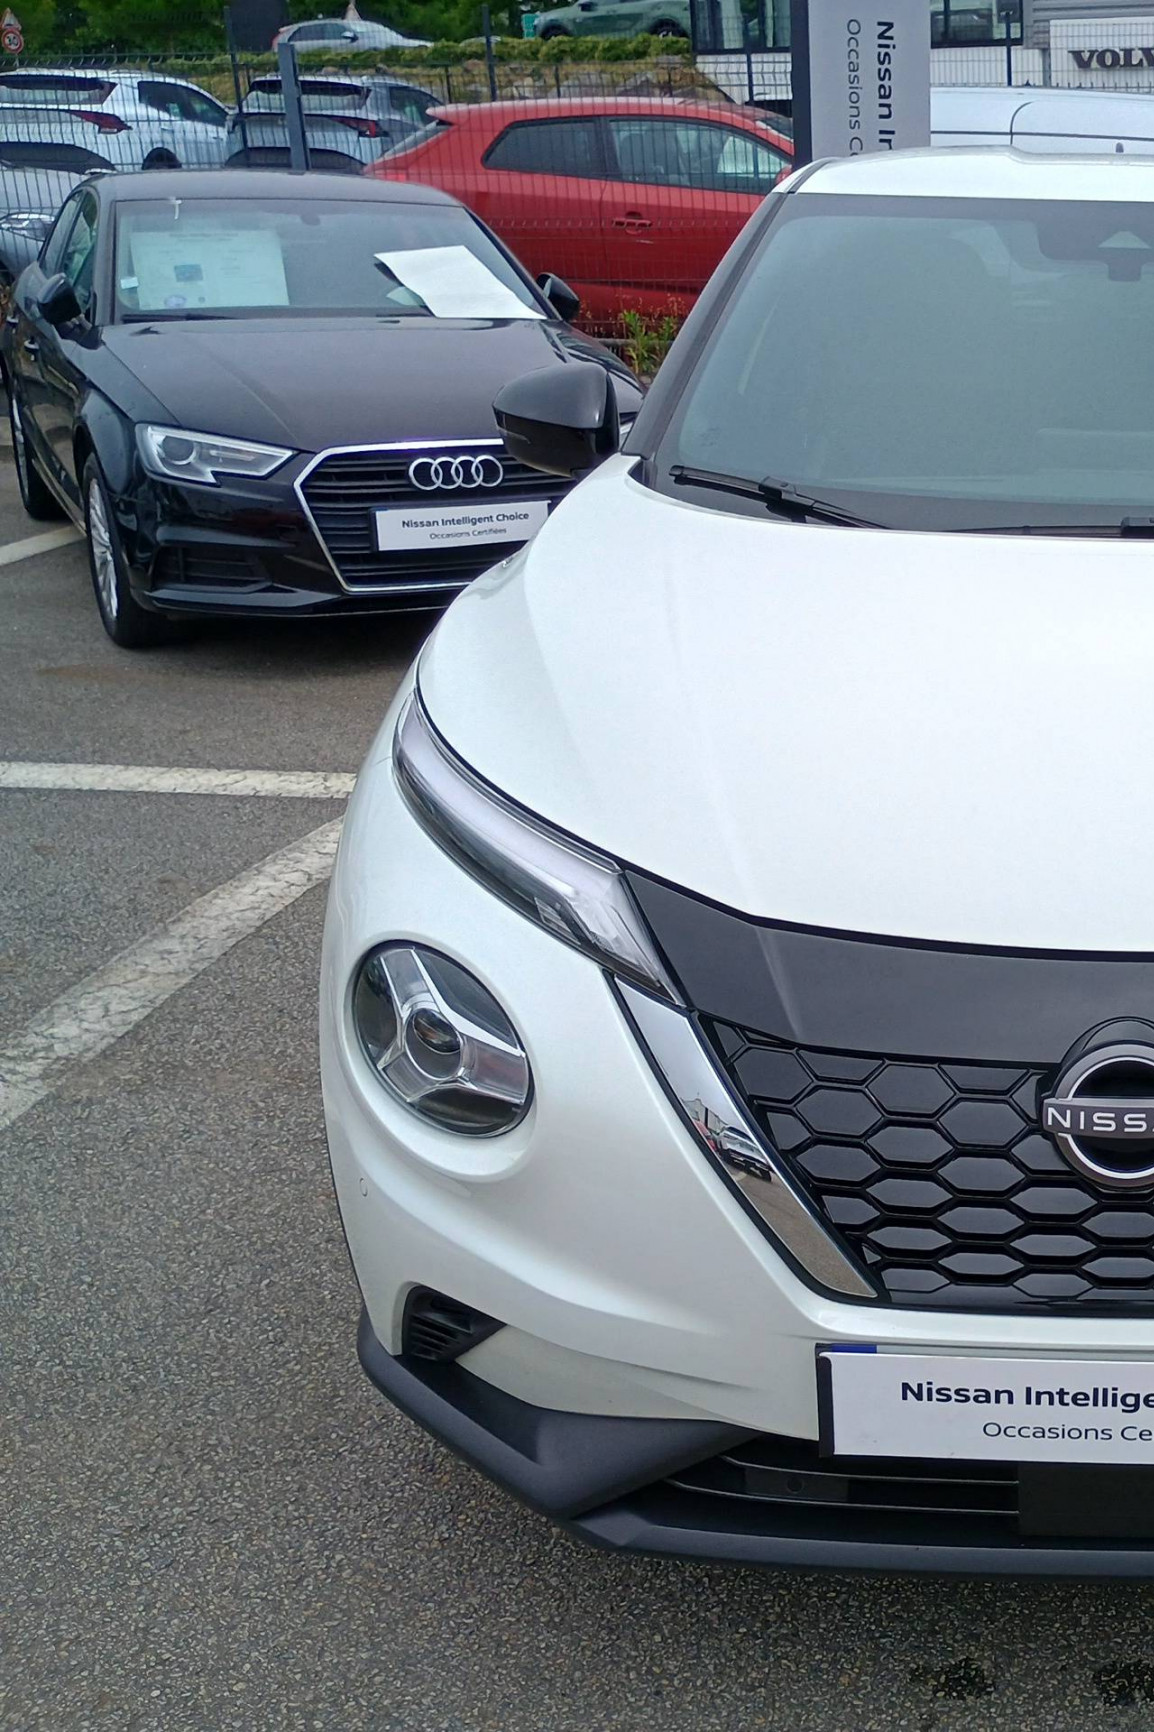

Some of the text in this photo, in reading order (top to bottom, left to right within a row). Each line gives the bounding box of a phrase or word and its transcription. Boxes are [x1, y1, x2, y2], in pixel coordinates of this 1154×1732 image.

[847, 19, 862, 130] Occasions
[877, 21, 896, 119] Nissan
[402, 512, 530, 529] Nissan Intelligent Choice
[900, 1381, 1015, 1406] Nissan
[982, 1421, 1114, 1441] Occasions
